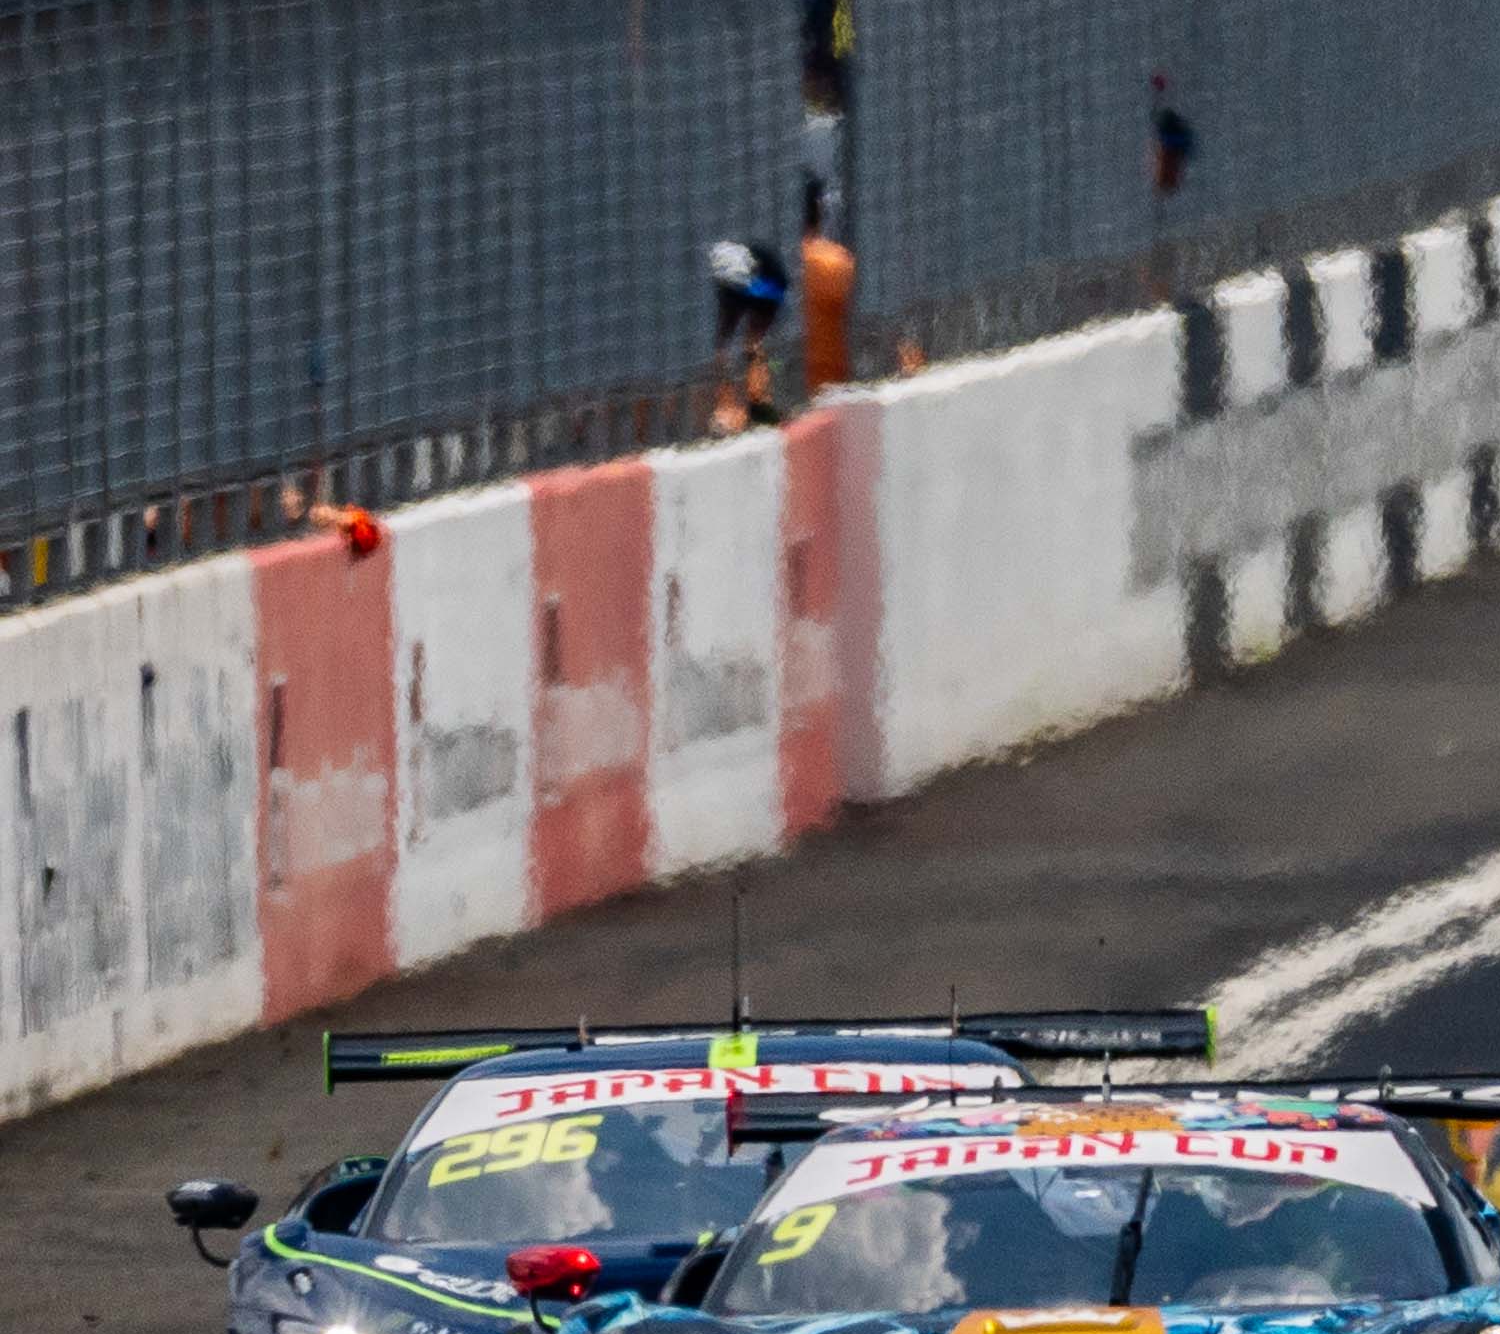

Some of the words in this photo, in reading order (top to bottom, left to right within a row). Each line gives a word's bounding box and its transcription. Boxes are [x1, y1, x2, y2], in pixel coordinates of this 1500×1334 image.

[497, 1067, 775, 1118] JAPAN
[427, 1113, 606, 1189] 296
[846, 1131, 1138, 1186] JAPAN
[1175, 1133, 1338, 1164] CUP
[758, 1203, 838, 1266] 9
